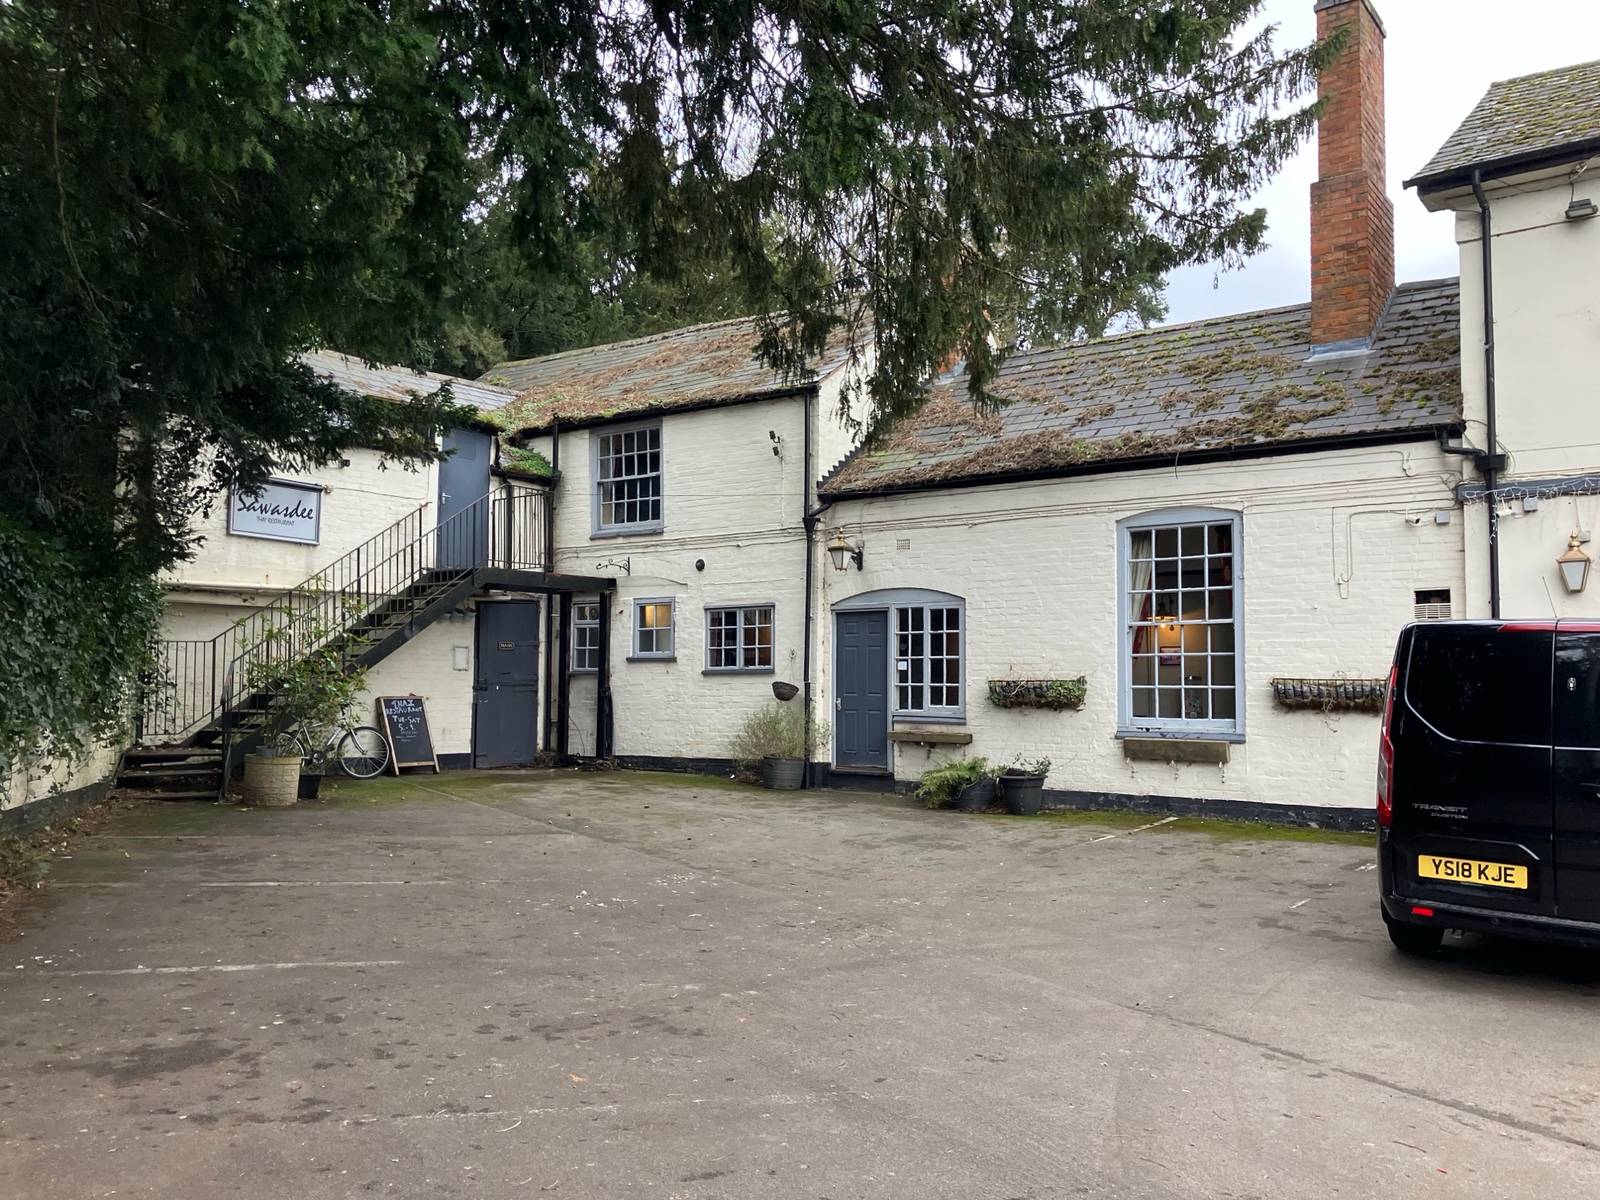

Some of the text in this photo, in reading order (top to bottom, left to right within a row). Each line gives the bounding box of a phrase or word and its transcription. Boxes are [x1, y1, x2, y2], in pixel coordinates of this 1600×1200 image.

[237, 492, 313, 519] Sawasdee
[1412, 802, 1468, 813] TRANSIT
[1431, 858, 1516, 884] YS18 KJE
